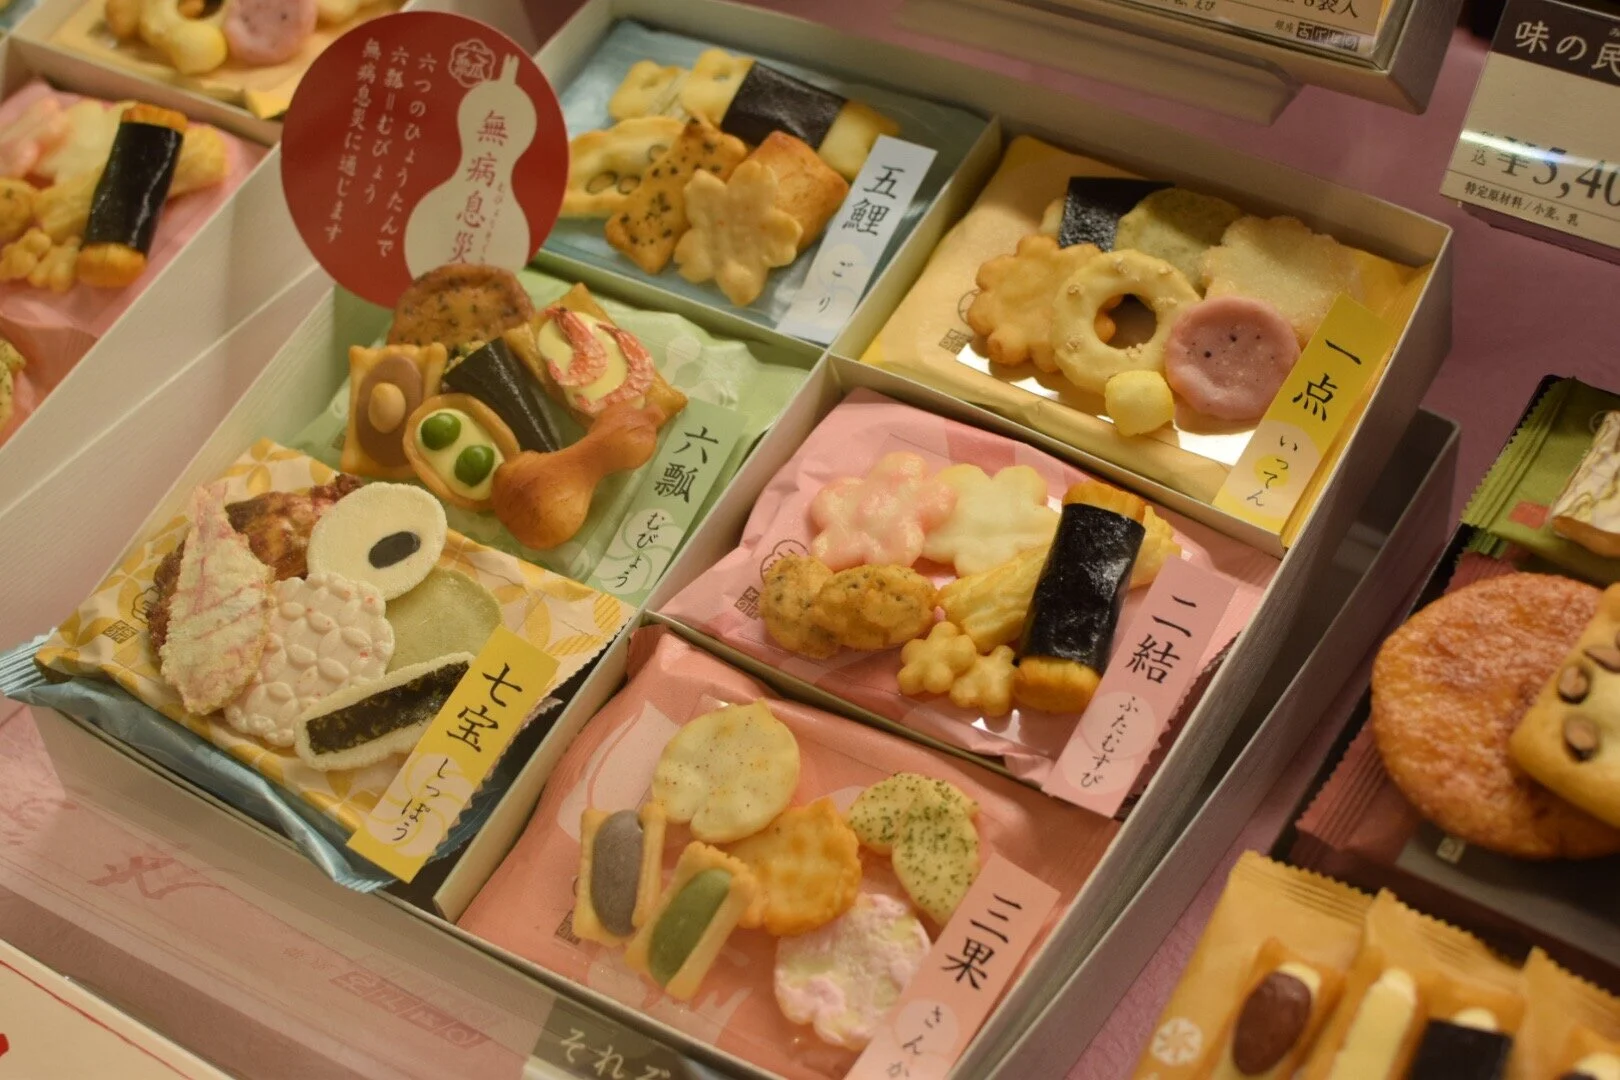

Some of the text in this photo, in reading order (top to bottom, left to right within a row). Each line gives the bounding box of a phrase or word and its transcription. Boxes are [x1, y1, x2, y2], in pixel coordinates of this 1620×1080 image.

[1515, 20, 1620, 78] 味の民
[324, 38, 381, 243] 無病息災に通じます
[377, 52, 437, 257] 六つのひょうたんで
[449, 110, 508, 264] 無病息災
[841, 165, 905, 236] 五鯉
[819, 261, 853, 313] ごり
[1292, 339, 1362, 421] 一点
[653, 426, 719, 503] 六瓢
[1247, 435, 1298, 506] いってん
[614, 512, 665, 588] むびょう
[1125, 595, 1197, 684] 二結
[446, 663, 523, 752] 七宝
[1080, 696, 1139, 788] ふたむすび
[392, 758, 449, 840] しっぽう
[941, 893, 1023, 990] 三果
[886, 1005, 942, 1078] さんか
